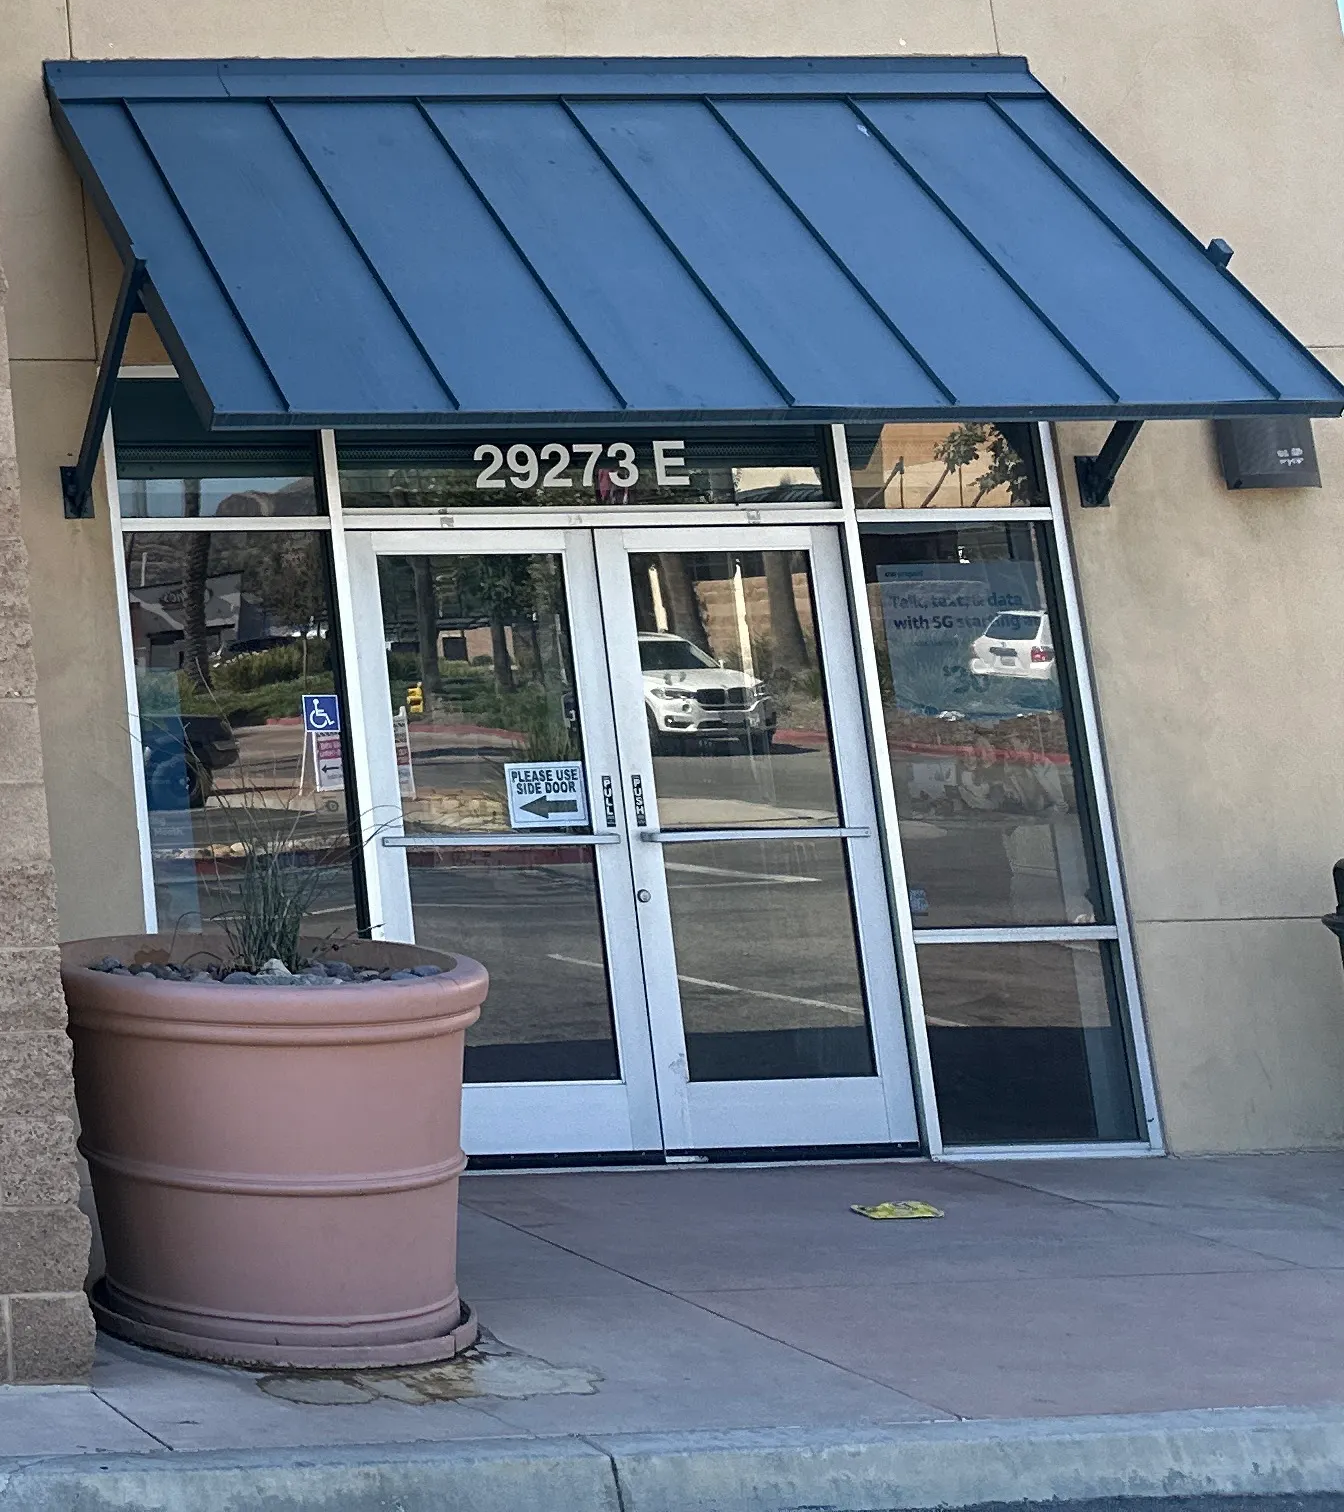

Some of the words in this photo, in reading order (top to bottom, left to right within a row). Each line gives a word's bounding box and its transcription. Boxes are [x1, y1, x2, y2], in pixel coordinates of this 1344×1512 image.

[473, 442, 639, 489] 29273
[652, 440, 691, 486] E
[988, 592, 1023, 607] data
[893, 615, 931, 630] with
[932, 615, 954, 628] 5G
[512, 769, 553, 782] PLEASE
[556, 768, 579, 780] USE
[516, 783, 542, 794] SIDE
[545, 780, 577, 793] DOOR
[602, 779, 614, 815] PULL
[632, 778, 645, 814] PUSH
